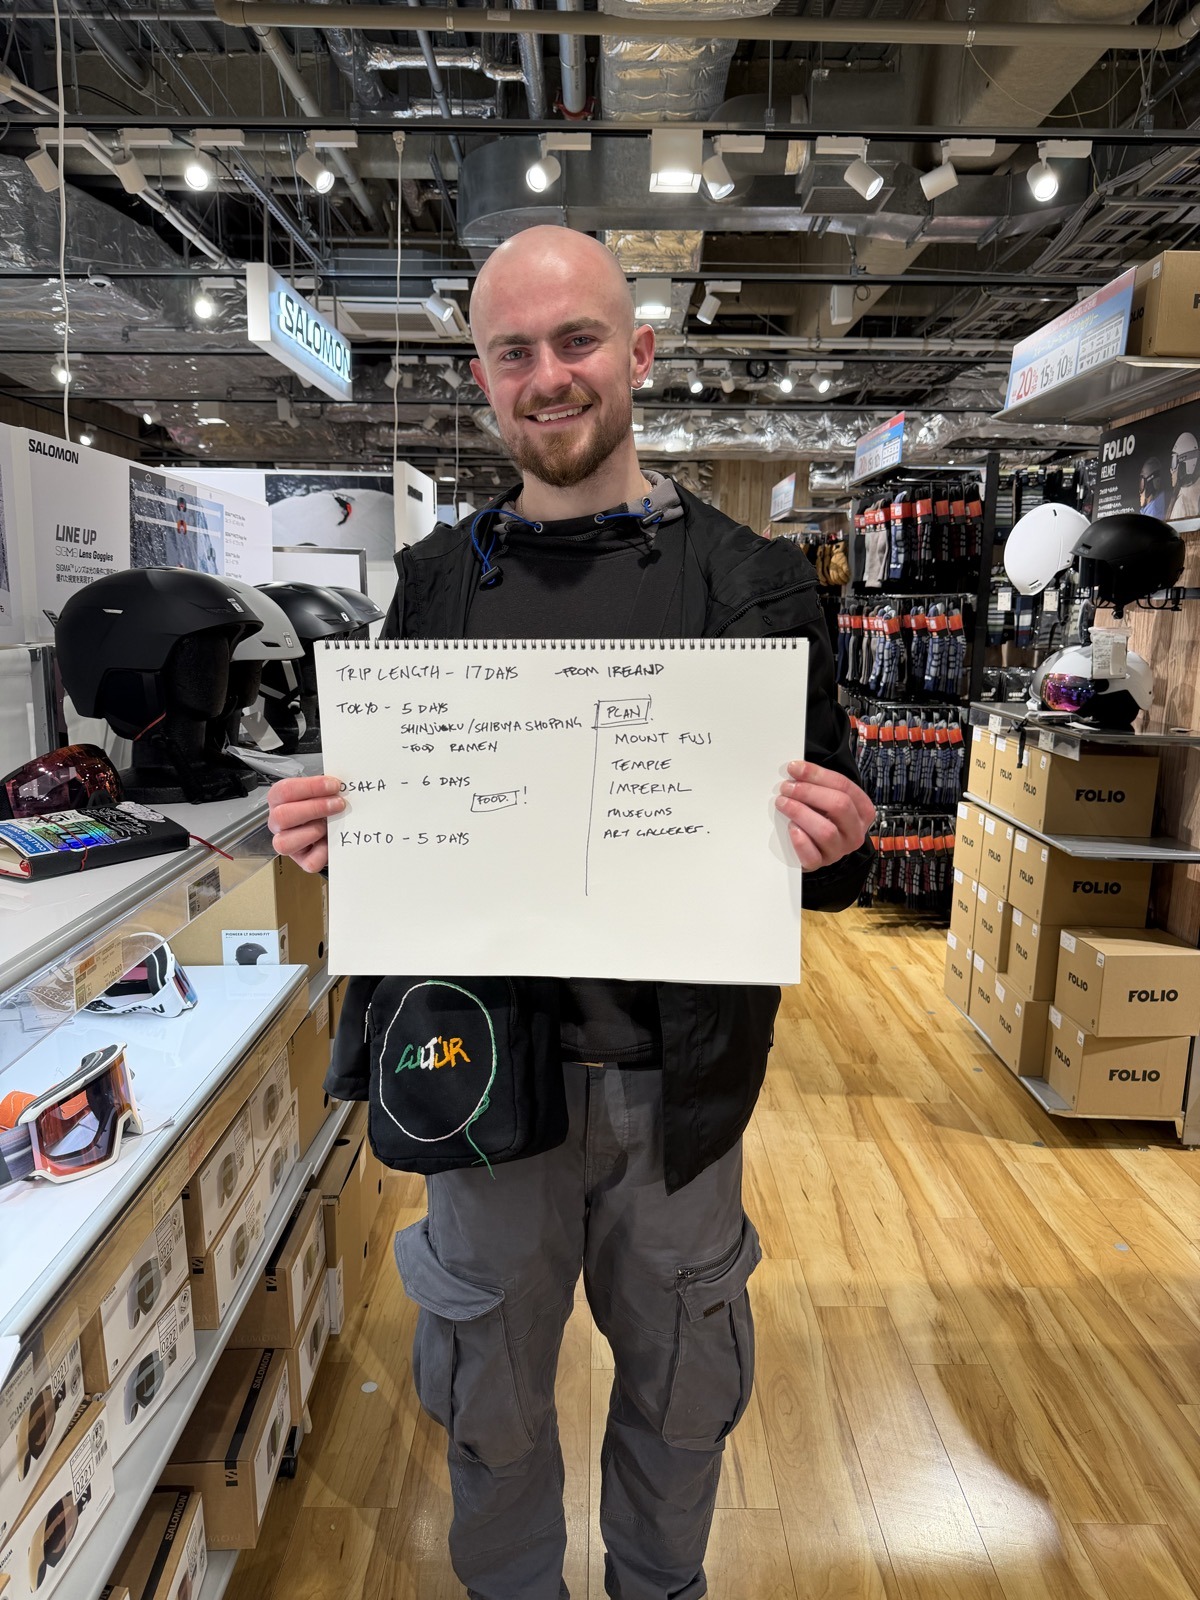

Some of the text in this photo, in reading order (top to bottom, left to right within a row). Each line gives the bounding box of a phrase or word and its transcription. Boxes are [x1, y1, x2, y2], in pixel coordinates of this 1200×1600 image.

[279, 291, 352, 382] SALOMON
[1016, 366, 1033, 400] 20
[1040, 364, 1050, 388] 15
[1057, 355, 1069, 380] 10
[28, 438, 79, 465] SALOMON
[1102, 434, 1136, 462] FOLIO
[1100, 463, 1117, 479] HELMET
[55, 524, 97, 545] LINE UP
[79, 548, 92, 559] Lens
[92, 550, 114, 562] Goggles
[336, 665, 372, 681] TRIP
[378, 665, 440, 681] LENGTH
[465, 665, 482, 680] 17
[484, 666, 519, 680] DAYS
[336, 702, 379, 715] TOKYO
[401, 703, 412, 715] 5
[418, 703, 449, 714] DAYS
[606, 705, 641, 719] PLAN
[615, 732, 712, 745] MOUNT FUJI
[450, 741, 498, 753] RAMEN
[611, 758, 672, 772] TEMPLE
[975, 758, 986, 770] FOLIO
[1000, 768, 1012, 781] FOLIO
[338, 779, 387, 793] OSAKA
[422, 776, 431, 787] 6
[439, 776, 471, 788] DAYS
[609, 781, 692, 795] IMPERIAL
[1023, 781, 1037, 796] FOLIO
[1075, 788, 1126, 803] FOLIO
[607, 807, 672, 818] MUSEUMS
[340, 831, 394, 847] KYOTO
[417, 832, 429, 845] 5
[436, 832, 470, 846] DAYS
[603, 829, 630, 839] ART
[962, 835, 974, 848] FOLIO
[988, 848, 1001, 863] FOLIO
[1019, 869, 1034, 885] FOLIO
[1072, 881, 1121, 895] FOLIO
[958, 899, 969, 913] FOLIO
[981, 918, 993, 934] FOLIO
[1015, 943, 1028, 960] FOLIO
[951, 963, 963, 980] FOLIO
[1068, 971, 1088, 992] FOLIO
[978, 987, 991, 1004] FOLIO
[1128, 989, 1179, 1003] FOLIO
[999, 1014, 1012, 1034] FOLIO
[1054, 1046, 1071, 1068] FOLIO
[1109, 1069, 1161, 1082] FOLIO
[252, 1352, 272, 1389] SALOMON
[75, 1463, 93, 1495] 0221
[165, 1495, 188, 1541] SALOMON
